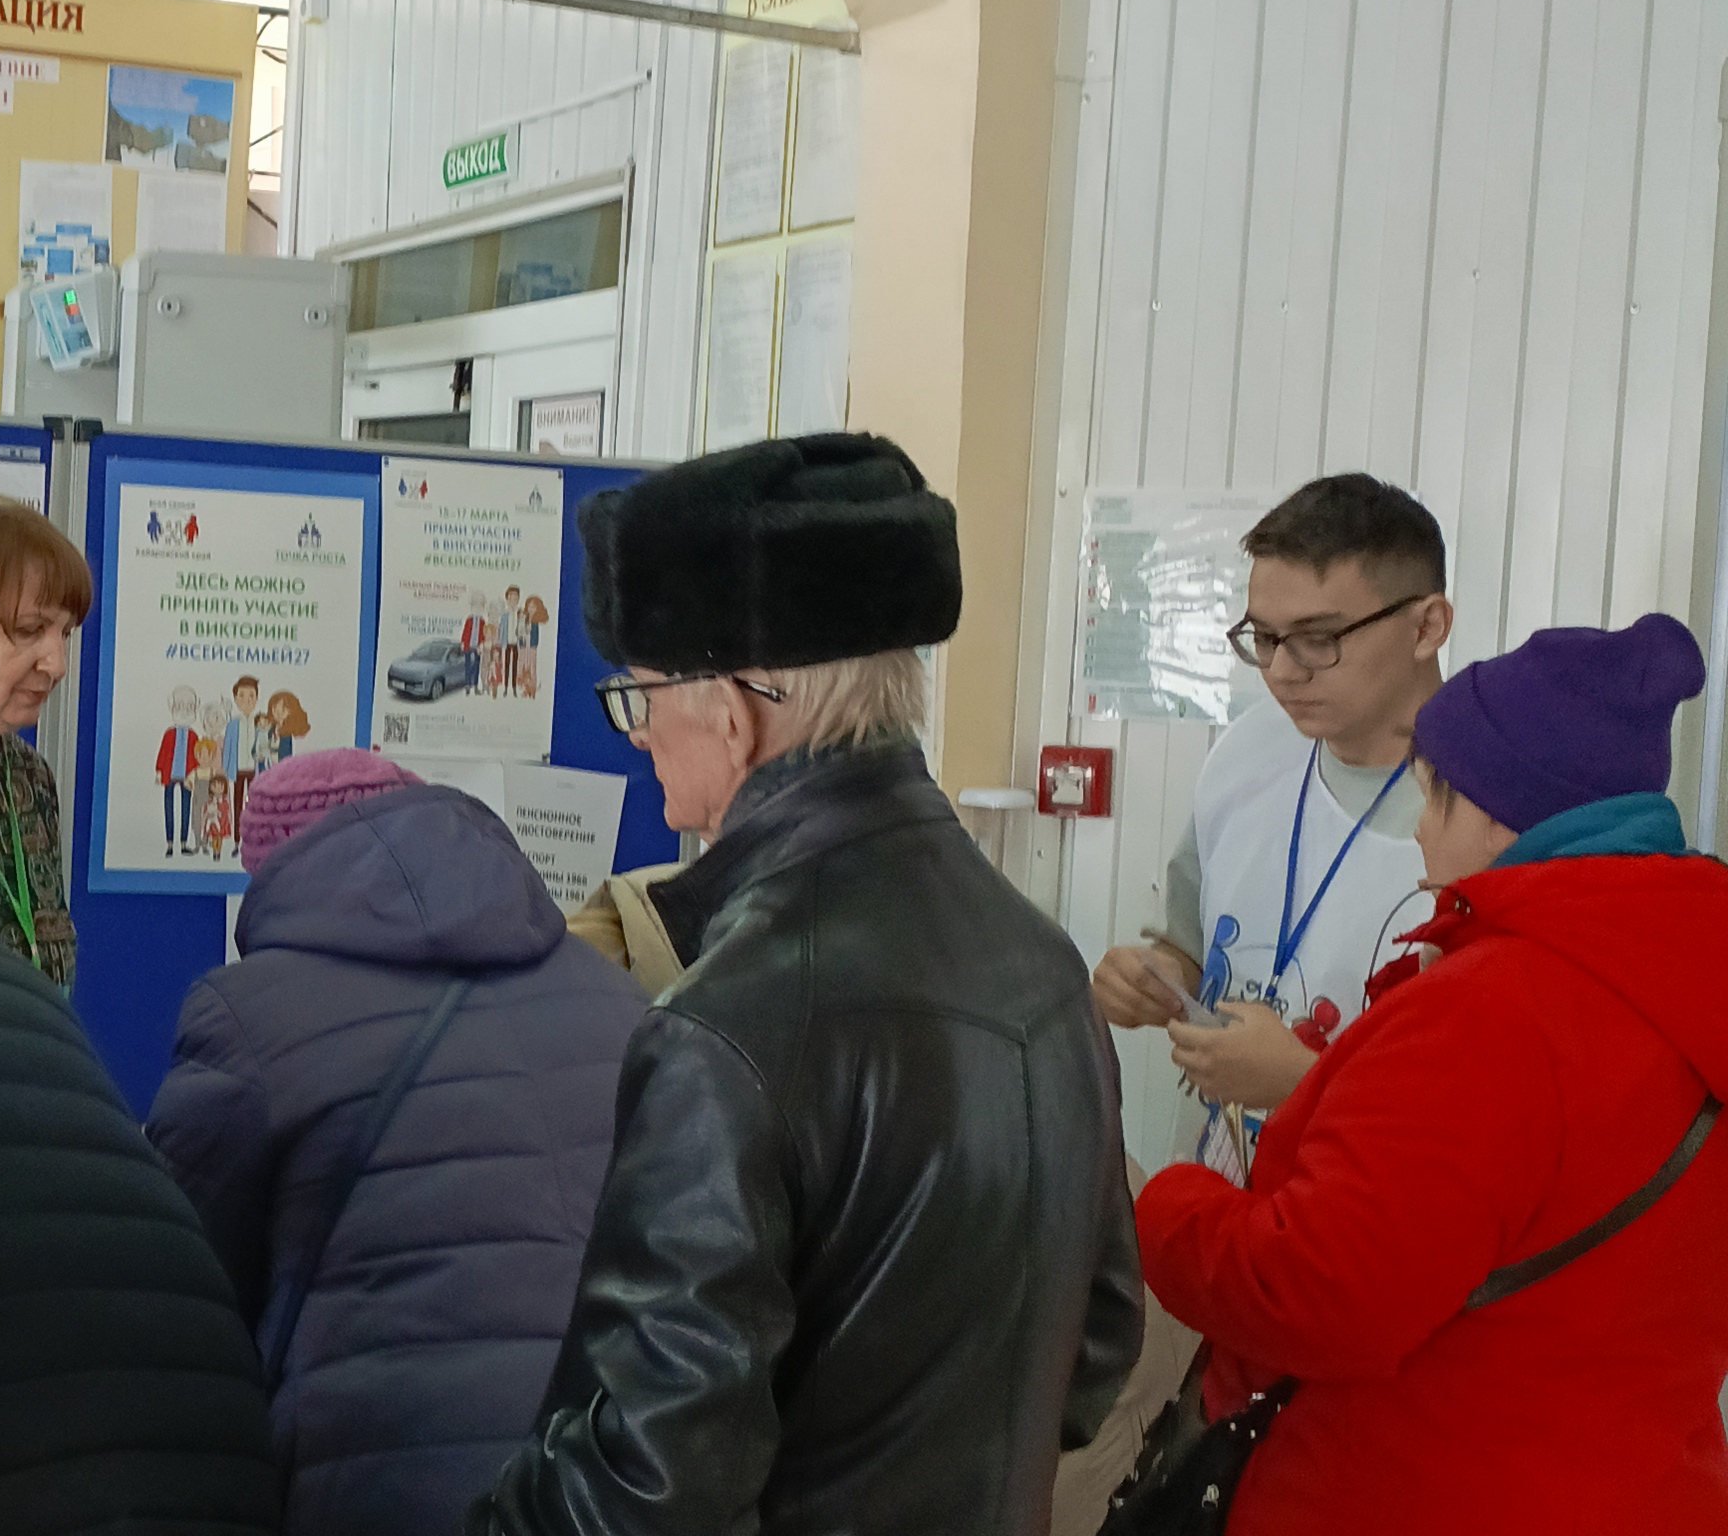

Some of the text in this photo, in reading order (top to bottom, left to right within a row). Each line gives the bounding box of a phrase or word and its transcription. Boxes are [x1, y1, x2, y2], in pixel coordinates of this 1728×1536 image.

[446, 138, 502, 185] ВЫХОД
[176, 570, 306, 594] ЗДЕСЬ МОЖНО
[160, 594, 319, 619] ПРИНЯТЬ УЧАСТИЕ
[179, 619, 298, 641] В ВИКТОРИНЕ
